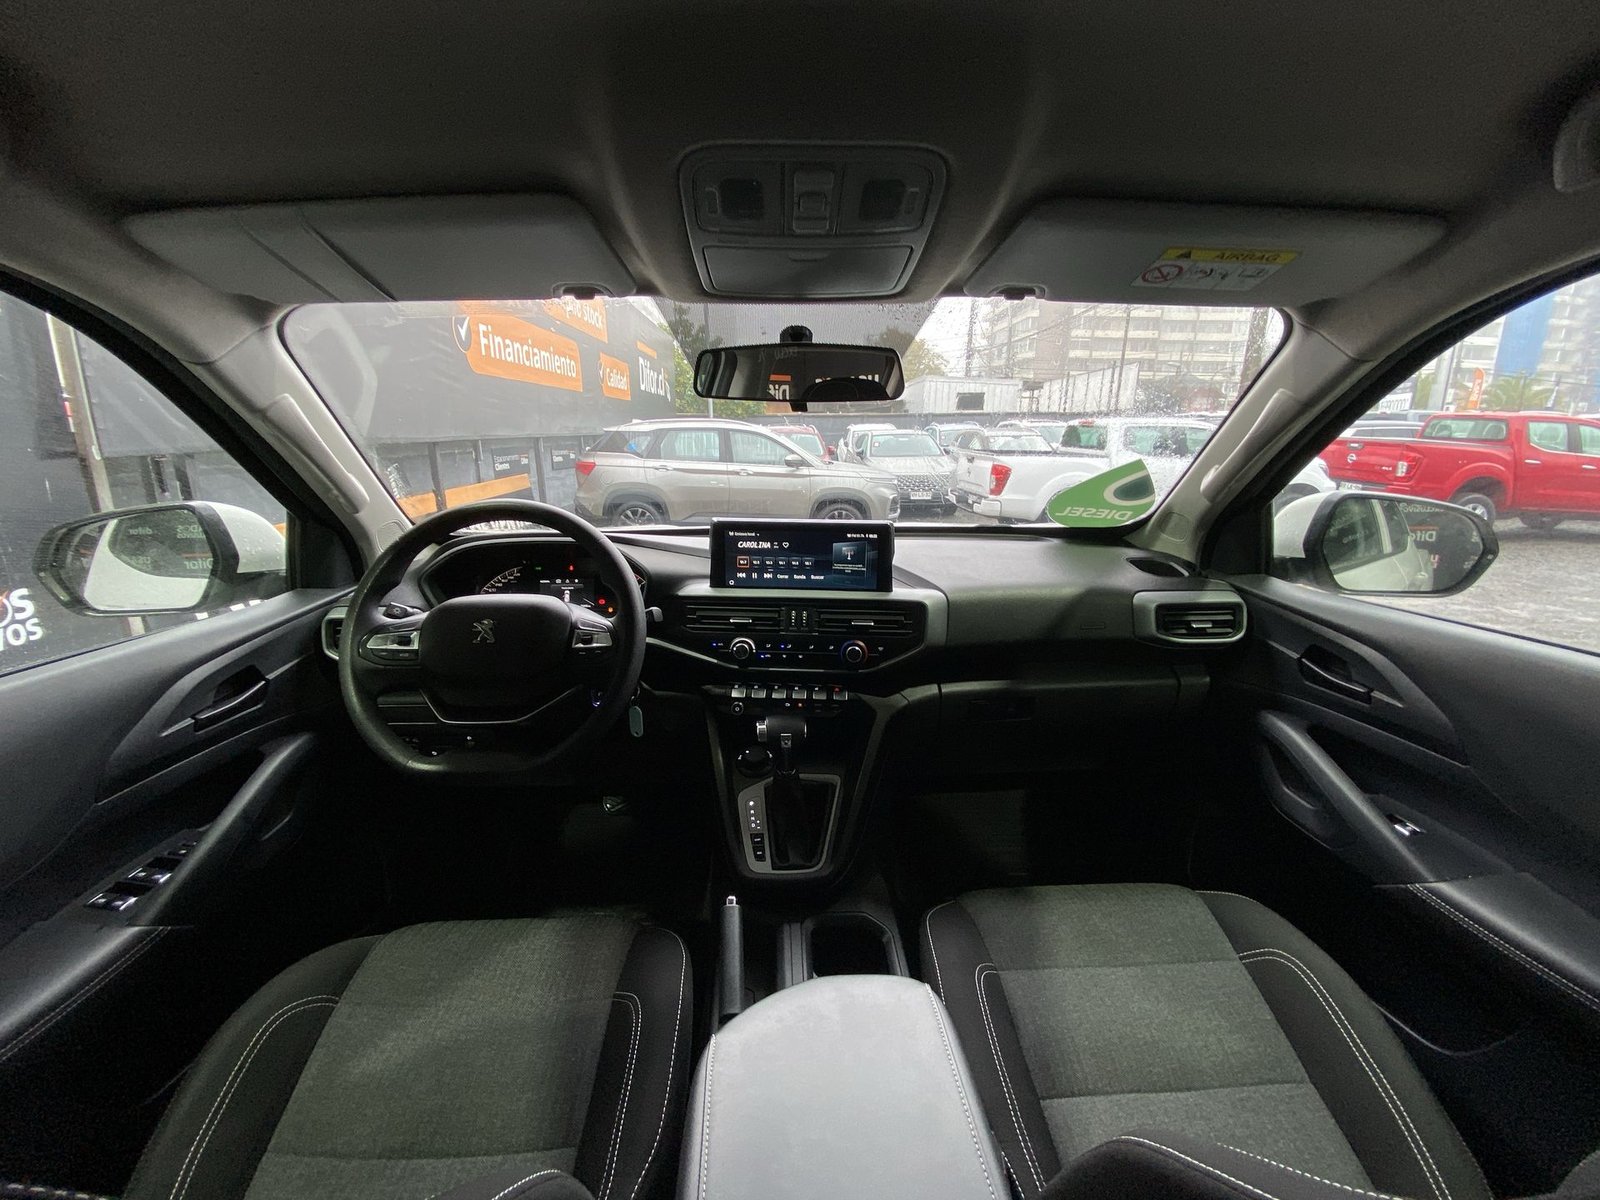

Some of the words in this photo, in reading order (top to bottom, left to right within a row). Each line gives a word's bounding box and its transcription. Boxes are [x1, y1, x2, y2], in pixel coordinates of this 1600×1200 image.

[1214, 251, 1281, 262] AIRBAG
[478, 323, 577, 378] Financiamiento
[606, 367, 628, 391] Calidad
[737, 541, 771, 549] CAROLINA
